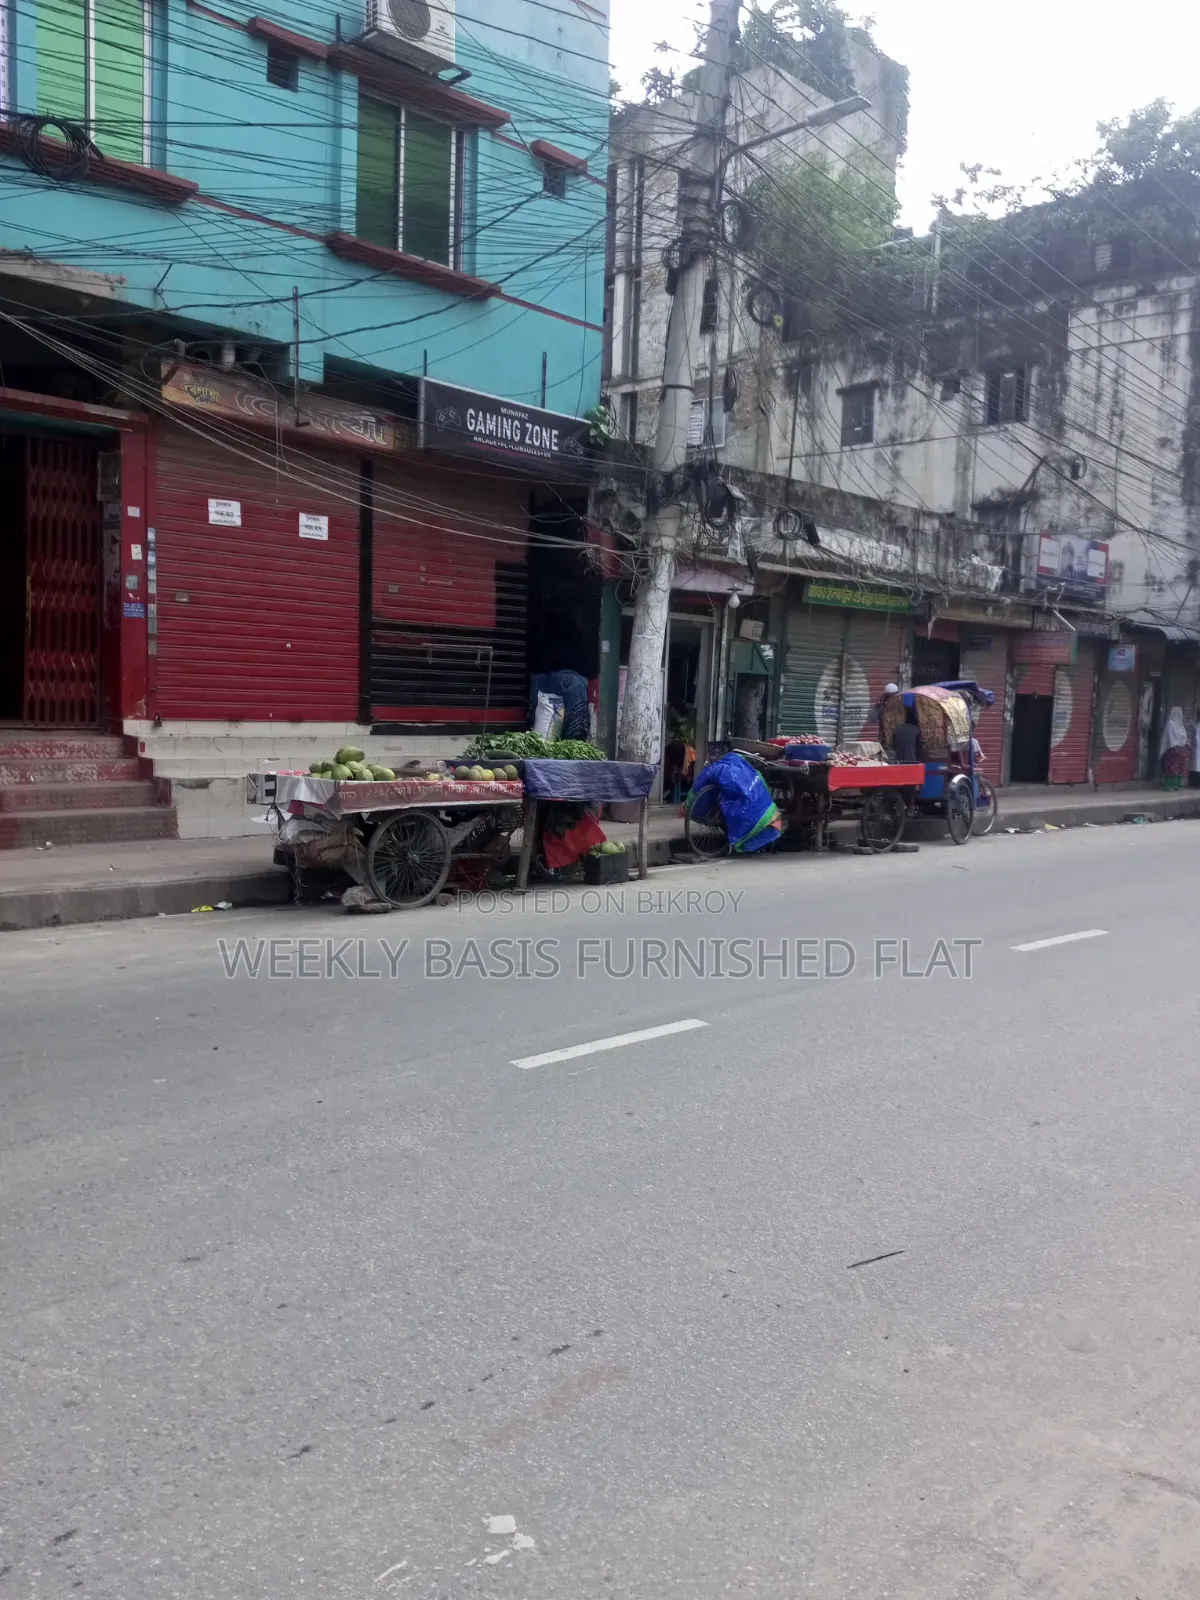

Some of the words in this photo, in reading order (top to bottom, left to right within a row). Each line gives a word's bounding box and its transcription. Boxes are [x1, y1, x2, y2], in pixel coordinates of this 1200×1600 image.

[500, 406, 529, 420] MUNAFAZ
[466, 408, 520, 442] GAMING
[525, 422, 559, 451] ZONE
